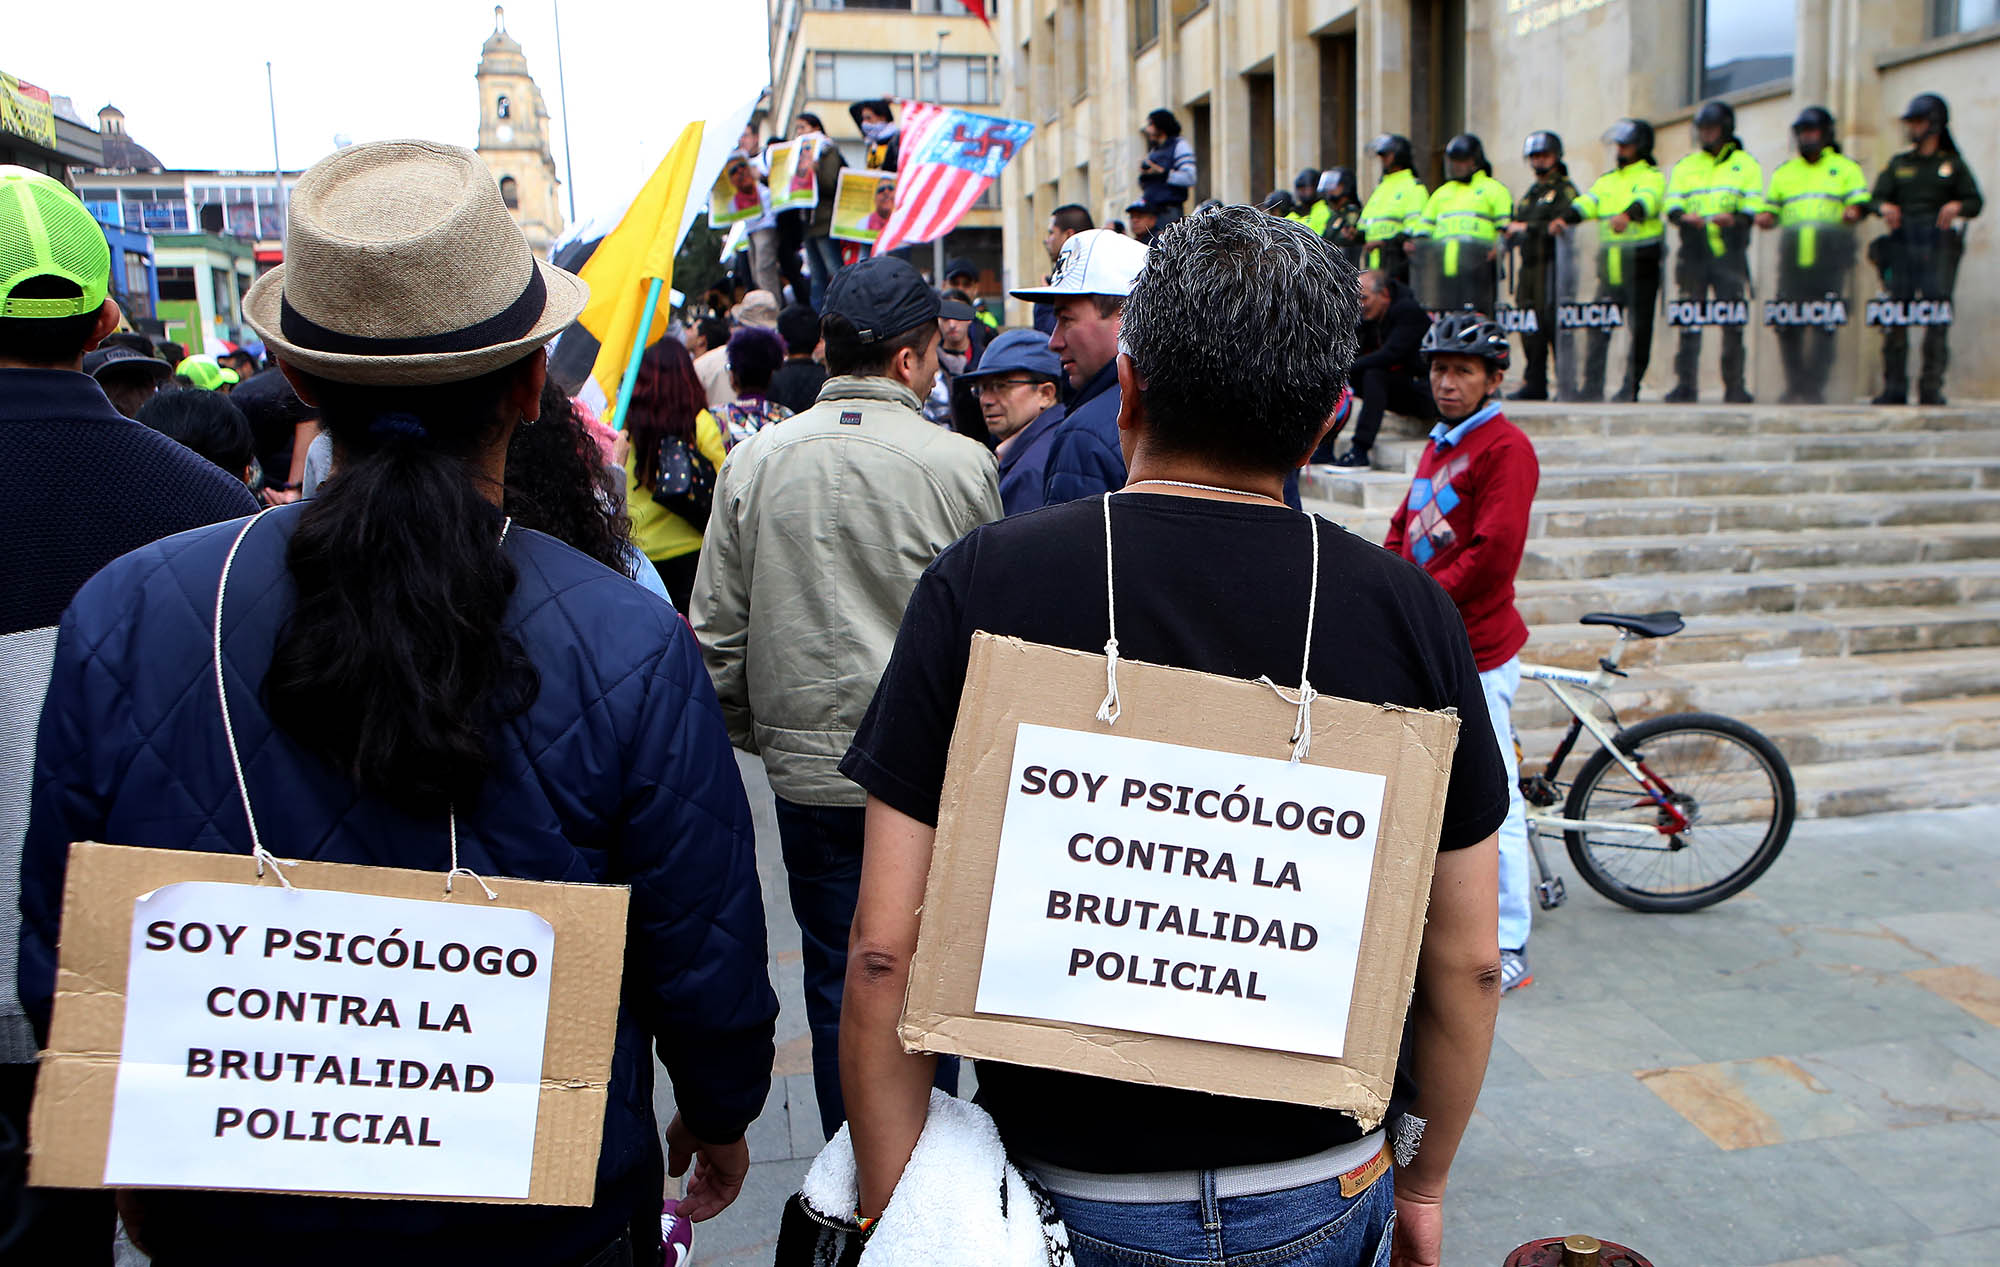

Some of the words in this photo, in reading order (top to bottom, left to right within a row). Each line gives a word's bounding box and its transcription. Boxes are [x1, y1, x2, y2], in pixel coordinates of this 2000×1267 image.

[1557, 303, 1623, 328] POLICIA
[1667, 301, 1748, 326] POLICIA
[1765, 300, 1848, 326] POLICIA
[1865, 300, 1954, 326] POLICIA
[1020, 765, 1109, 804] SOY
[1120, 778, 1366, 840] PSICÓLOGO
[1067, 832, 1237, 883] CONTRA
[1252, 857, 1302, 892] LA
[1046, 889, 1318, 952] BRUTALIDAD
[145, 920, 247, 955] SOY
[263, 927, 537, 978] PSICÓLOGO
[1068, 948, 1267, 1001] POLICIAL
[206, 986, 401, 1029] CONTRA
[418, 1001, 472, 1034] LA
[186, 1047, 494, 1093] BRUTALIDAD
[214, 1107, 441, 1147] POLICIAL
